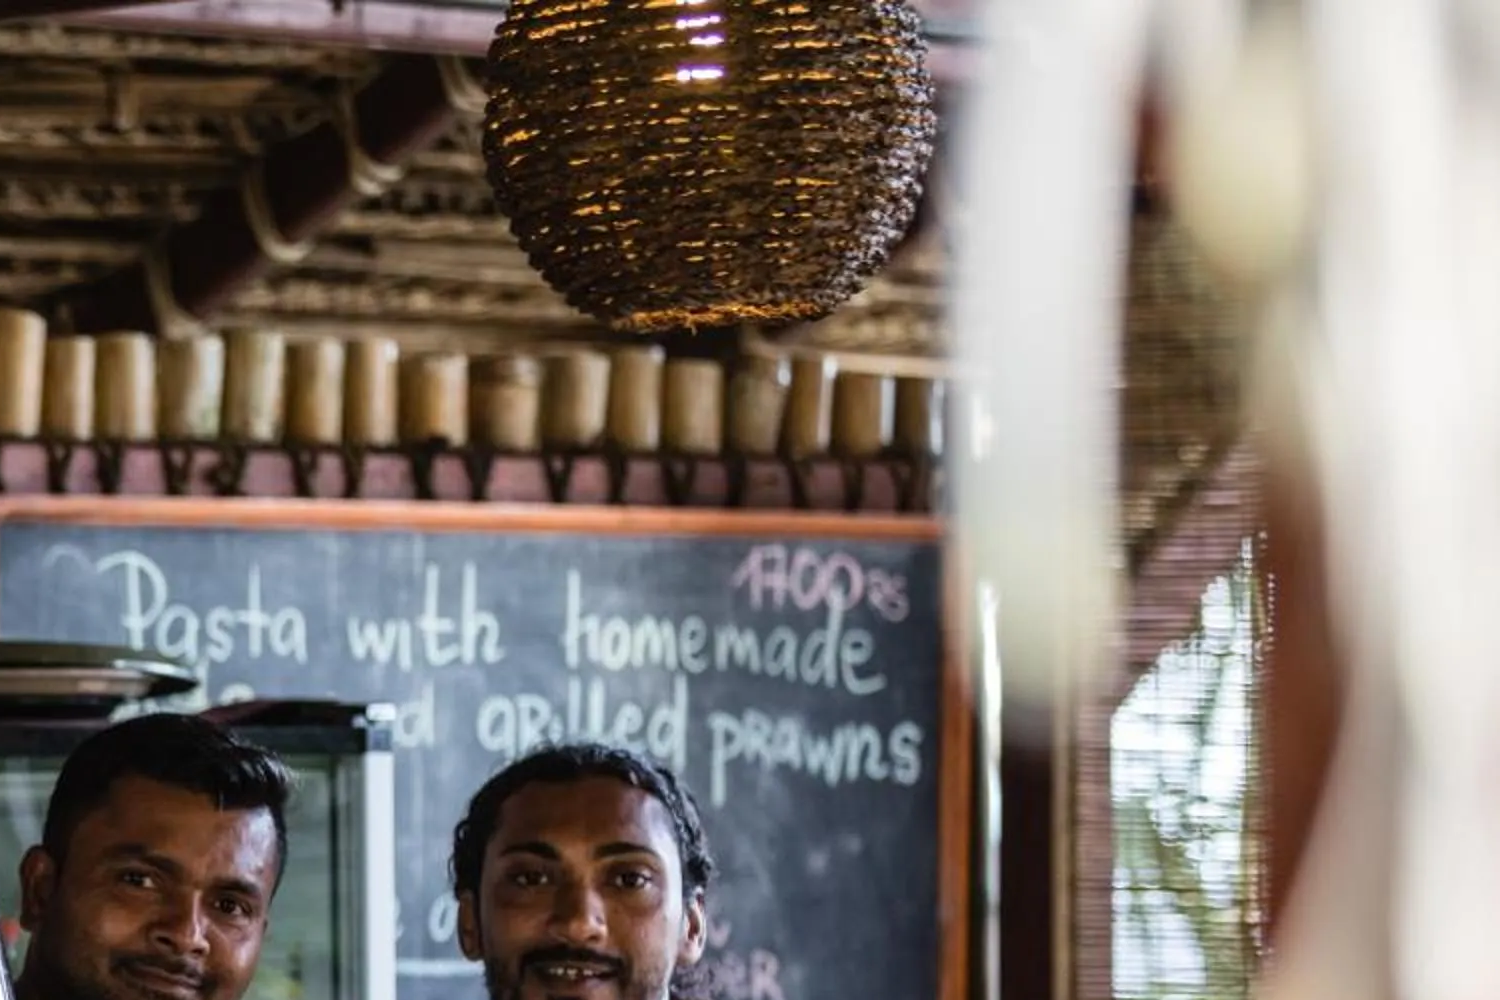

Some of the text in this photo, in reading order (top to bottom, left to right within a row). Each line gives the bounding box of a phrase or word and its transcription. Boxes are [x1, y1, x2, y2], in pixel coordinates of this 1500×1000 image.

[97, 549, 888, 695] Pasta with homemade
